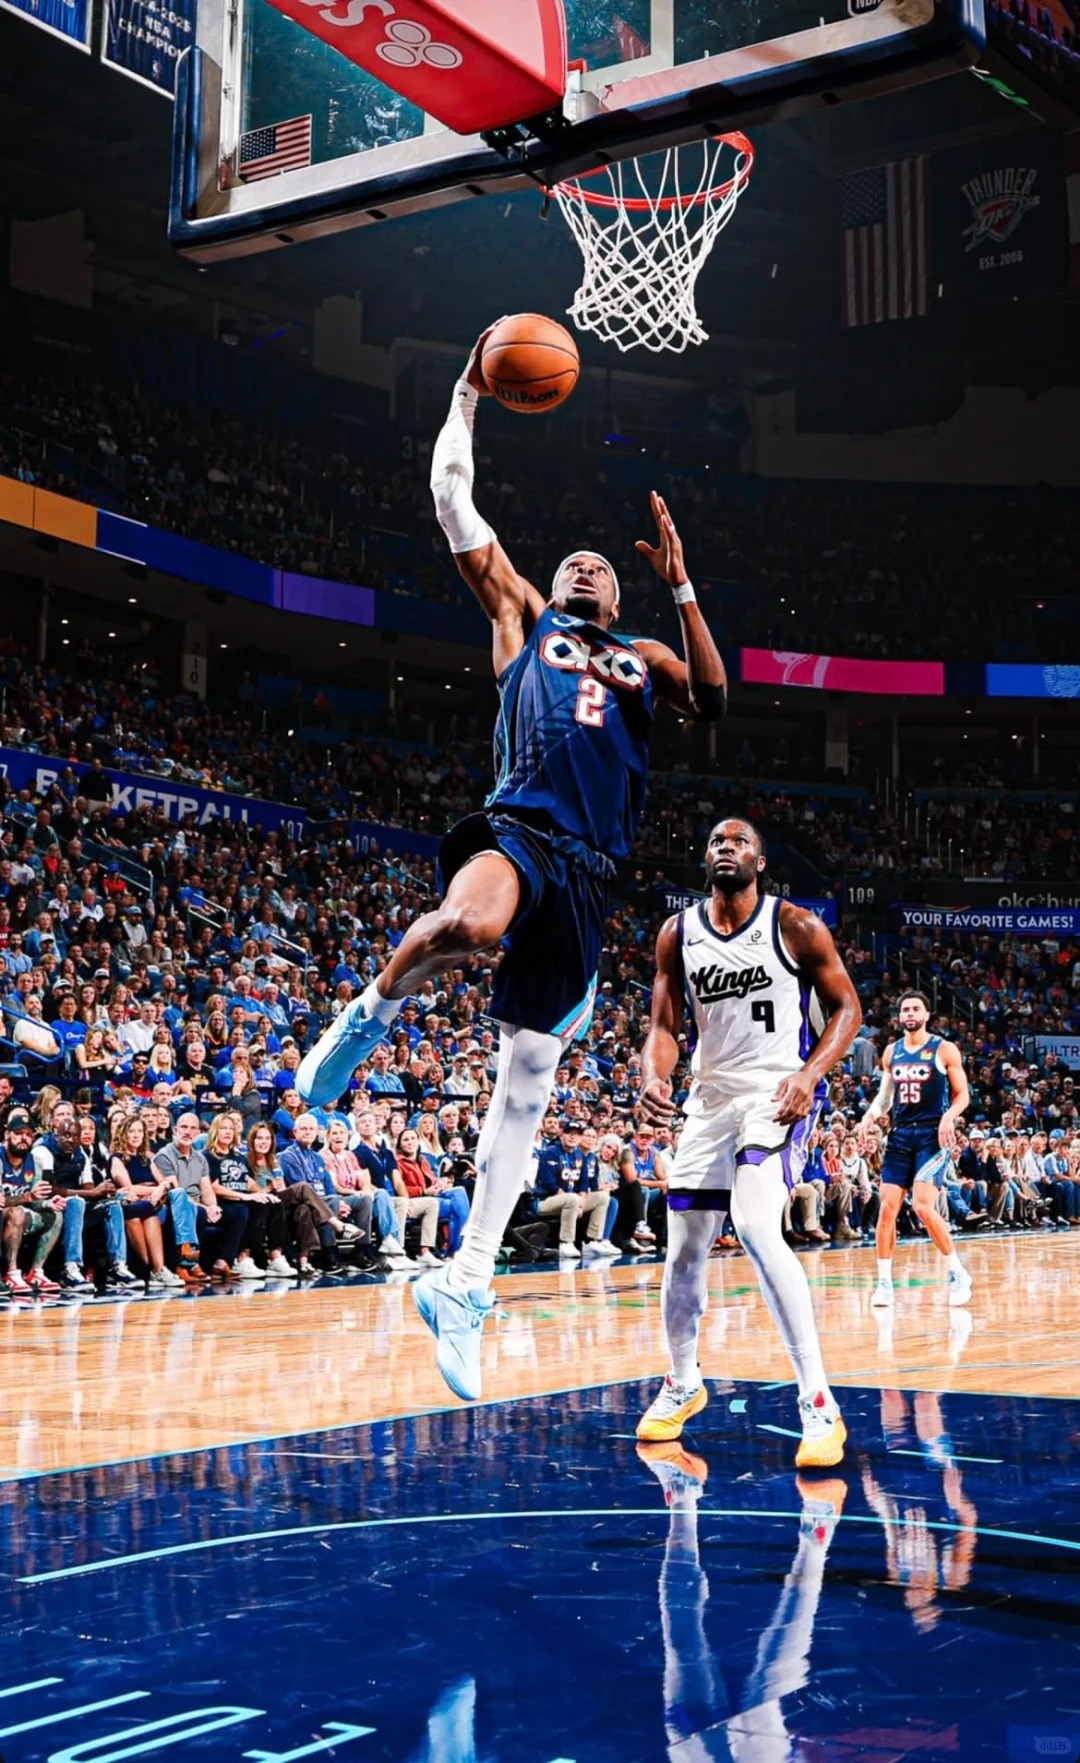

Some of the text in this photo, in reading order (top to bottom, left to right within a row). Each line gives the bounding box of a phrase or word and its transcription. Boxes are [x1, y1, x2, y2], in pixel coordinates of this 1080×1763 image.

[144, 15, 171, 39] NBA
[960, 167, 1038, 207] THUNDER
[495, 387, 560, 405] Wilson
[574, 674, 606, 728] 2
[36, 768, 254, 832] BKETBALL
[281, 818, 304, 842] 07
[665, 894, 690, 909] THE
[848, 887, 875, 905] 109
[903, 911, 1074, 928] YOUR FAVORITE GAMES!
[689, 963, 772, 1004] Kings
[751, 1000, 775, 1034] 9
[891, 1063, 932, 1082] OKC
[899, 1082, 921, 1104] 25
